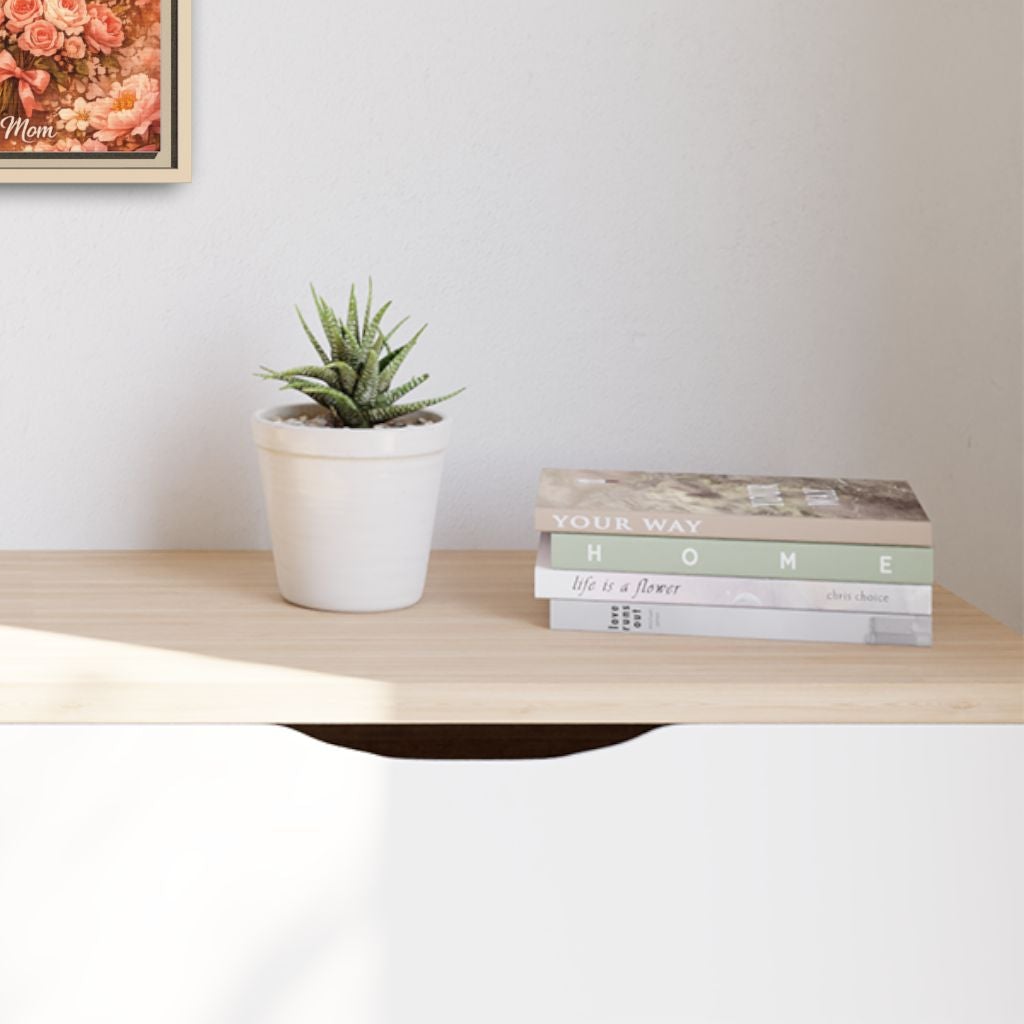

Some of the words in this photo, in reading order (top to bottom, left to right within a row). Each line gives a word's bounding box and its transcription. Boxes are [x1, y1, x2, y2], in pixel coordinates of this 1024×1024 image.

[0, 115, 57, 143] Mom
[552, 514, 633, 532] YOUR
[642, 517, 703, 534] WAY
[572, 575, 595, 597] life
[602, 578, 615, 593] is
[619, 581, 629, 593] a
[631, 577, 682, 600] flower
[826, 587, 852, 602] chris
[607, 605, 620, 630] love
[622, 605, 631, 631] runs
[631, 608, 642, 629] out
